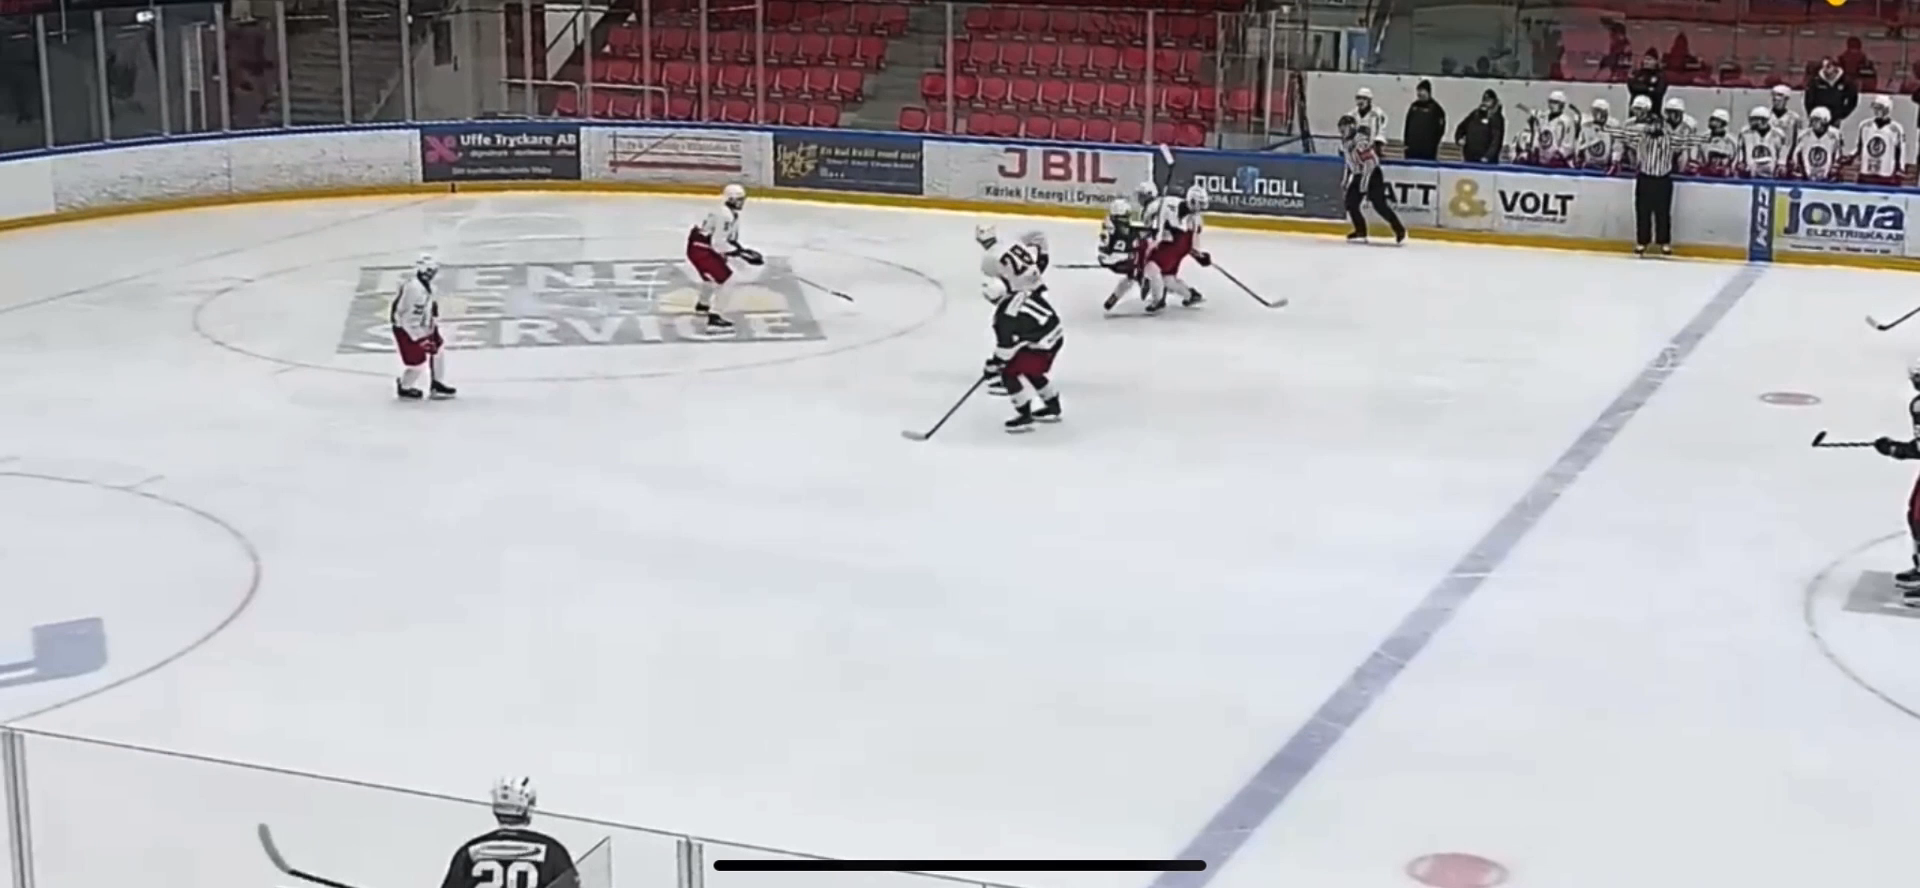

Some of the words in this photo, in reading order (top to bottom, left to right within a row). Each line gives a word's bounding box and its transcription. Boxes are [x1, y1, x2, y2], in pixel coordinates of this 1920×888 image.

[460, 133, 491, 146] Uffe
[495, 133, 553, 148] Tryckare
[556, 134, 576, 145] AB
[998, 148, 1028, 178] J
[1042, 150, 1117, 184] BIL
[1031, 187, 1068, 202] Energi
[1384, 182, 1436, 206] ATT
[1448, 178, 1489, 217] &
[1498, 190, 1574, 216] VOLT
[1756, 186, 1770, 247] CCM
[1784, 187, 1904, 235] jowa
[1806, 228, 1884, 241] ELEKTRISKA
[1886, 231, 1904, 241] AB
[1000, 243, 1035, 275] 28
[472, 860, 538, 888] 20
